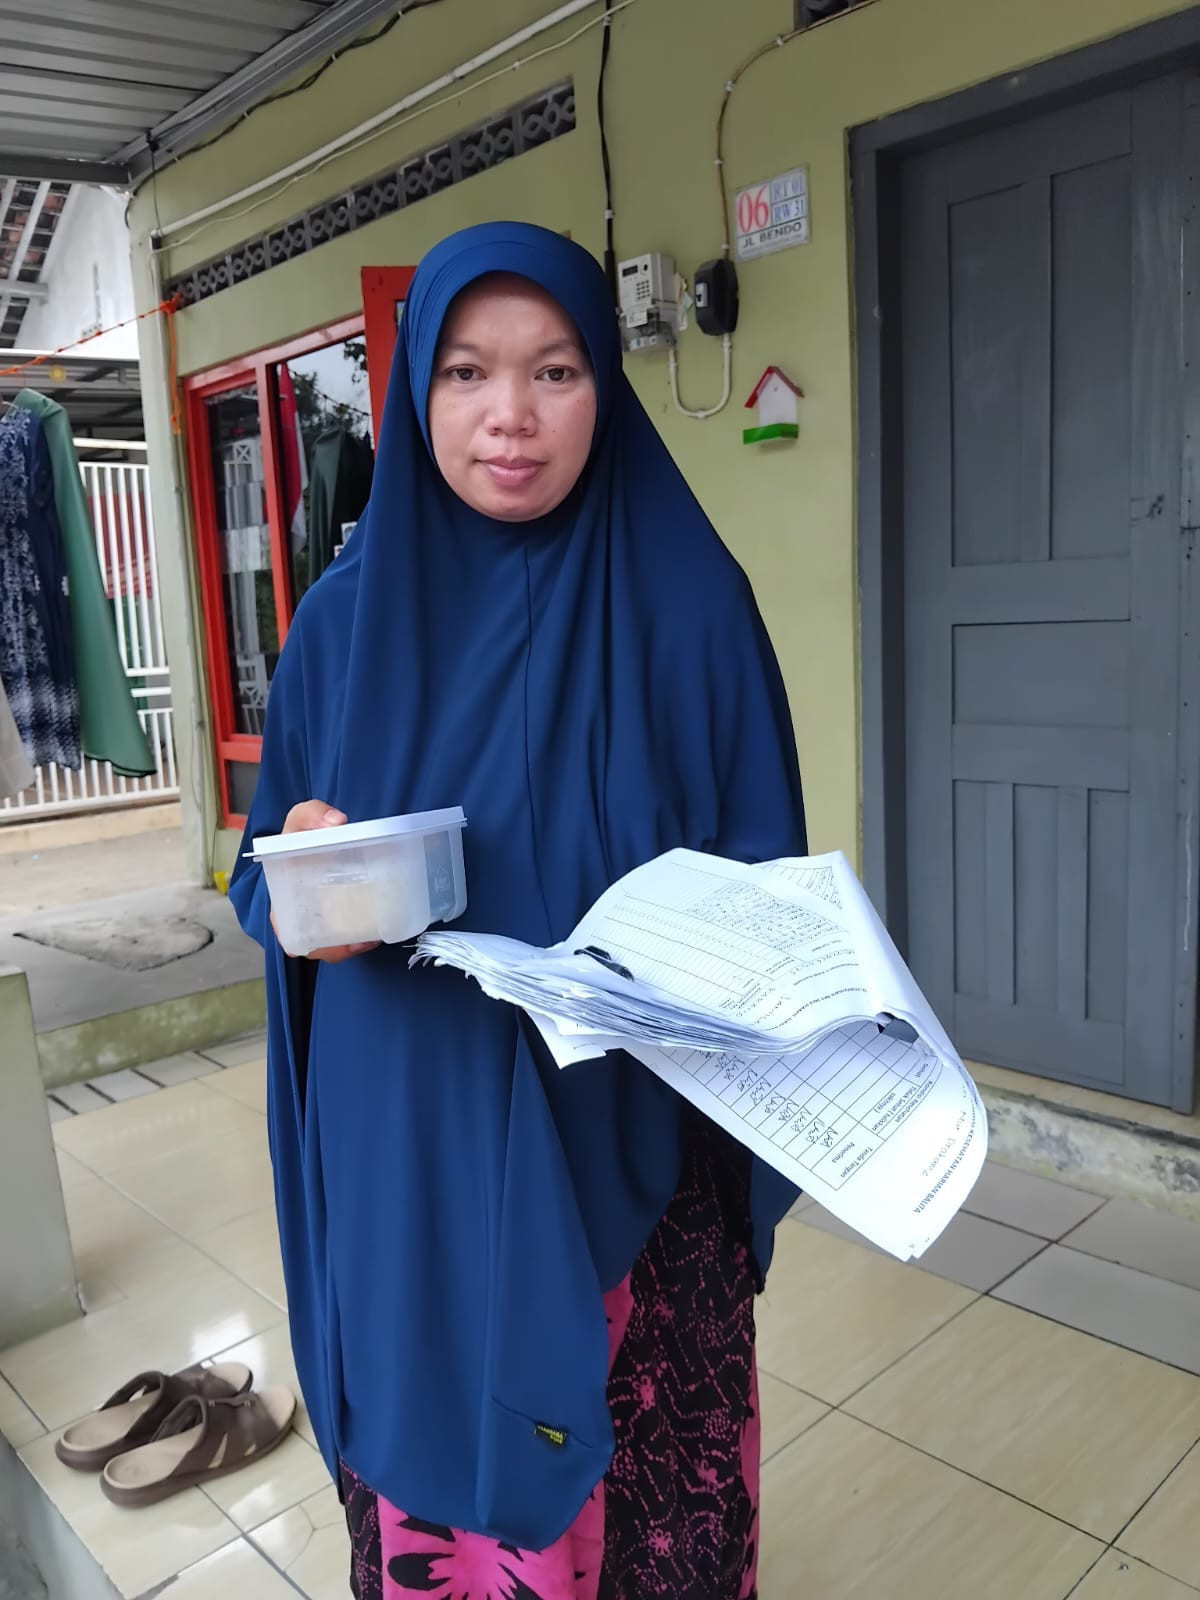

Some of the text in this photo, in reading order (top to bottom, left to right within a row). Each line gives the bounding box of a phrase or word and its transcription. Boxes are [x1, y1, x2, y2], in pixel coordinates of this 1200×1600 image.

[738, 184, 769, 234] 06
[773, 203, 792, 222] RW
[743, 237, 756, 248] JL
[759, 221, 802, 242] BENDO
[831, 1142, 855, 1163] Penerima
[840, 1146, 873, 1178] Tanda Tangan
[913, 1129, 974, 1214] KESEHATAN HARIAN BALITA
